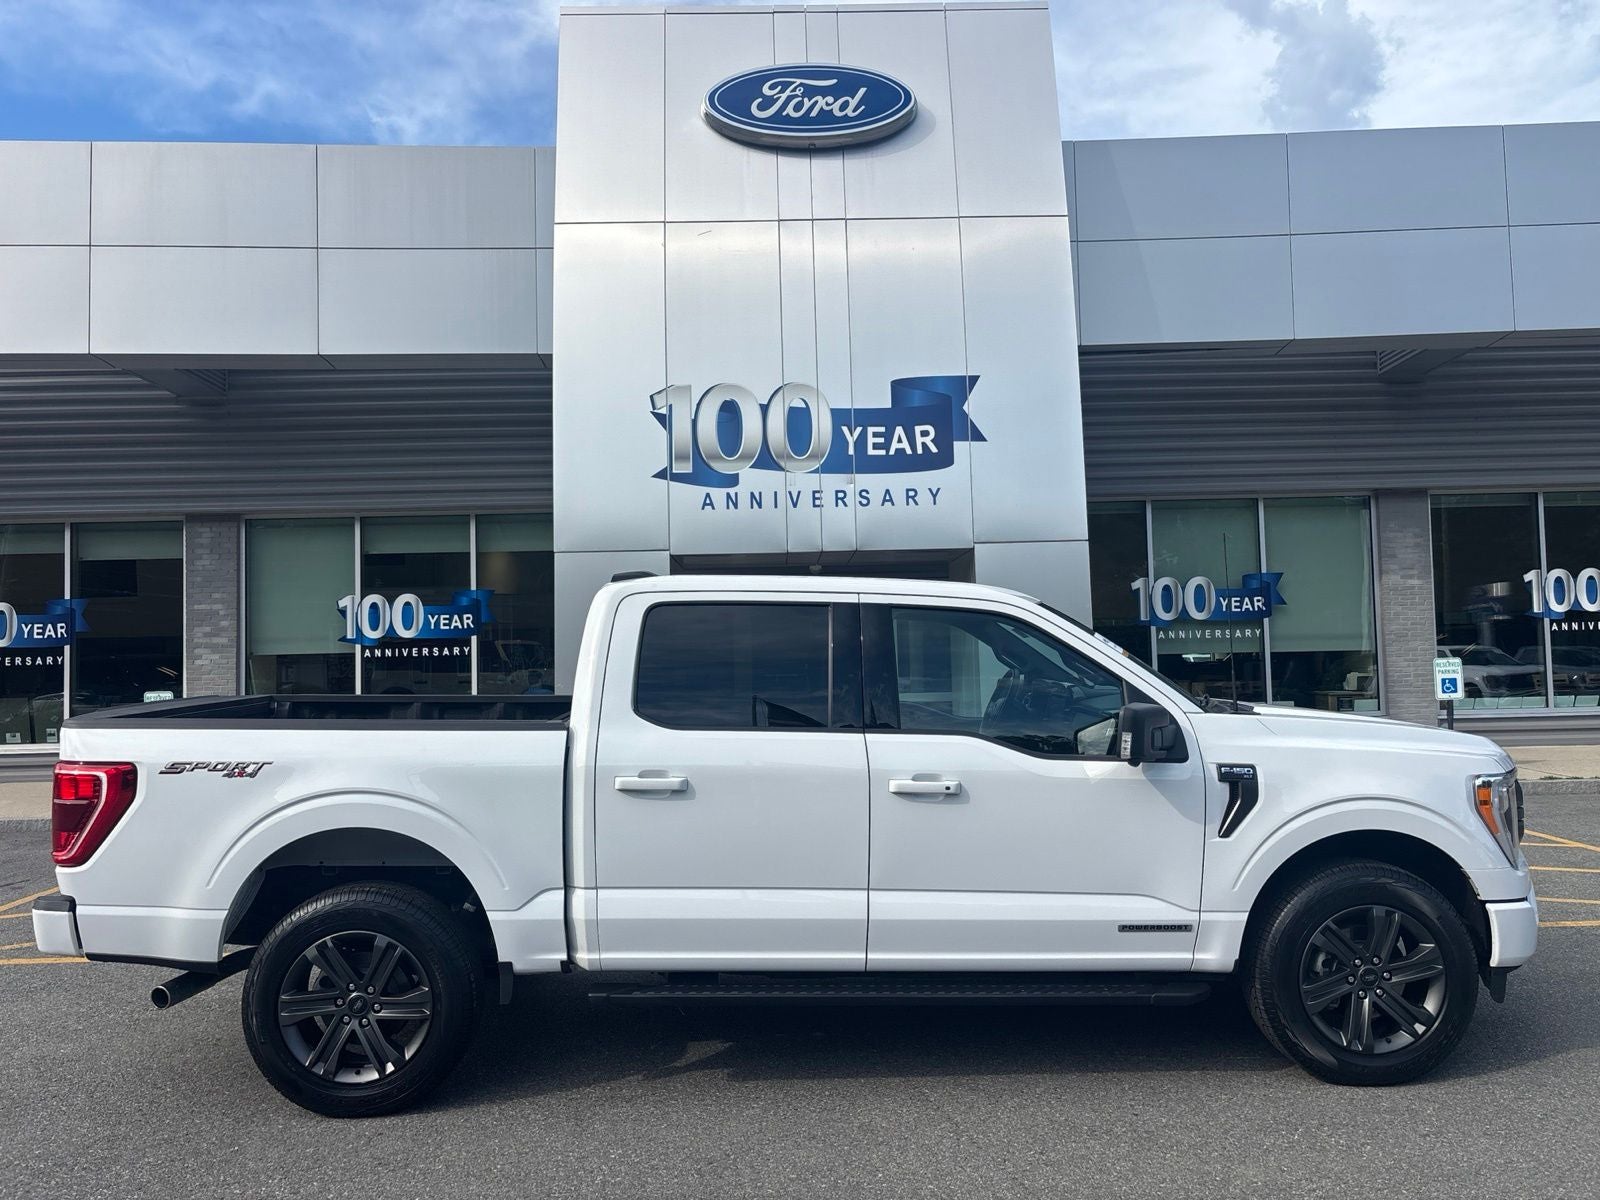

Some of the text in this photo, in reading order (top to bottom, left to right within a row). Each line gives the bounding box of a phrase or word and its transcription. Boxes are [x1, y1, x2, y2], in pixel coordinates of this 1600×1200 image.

[750, 77, 868, 119] Ford
[649, 381, 939, 474] 100 YEAR
[700, 487, 942, 511] ANNIVERSARY
[1131, 576, 1266, 620] 100 YEAR
[1522, 567, 1600, 613] 100
[337, 593, 474, 639] 100 YEAR
[21, 623, 68, 639] YEAR
[1158, 628, 1262, 640] ANNIVERSARY
[0, 656, 63, 667] ERSARY
[364, 646, 471, 658] ANNIVERSARY
[158, 760, 274, 775] SPORT
[1221, 767, 1254, 775] F-150
